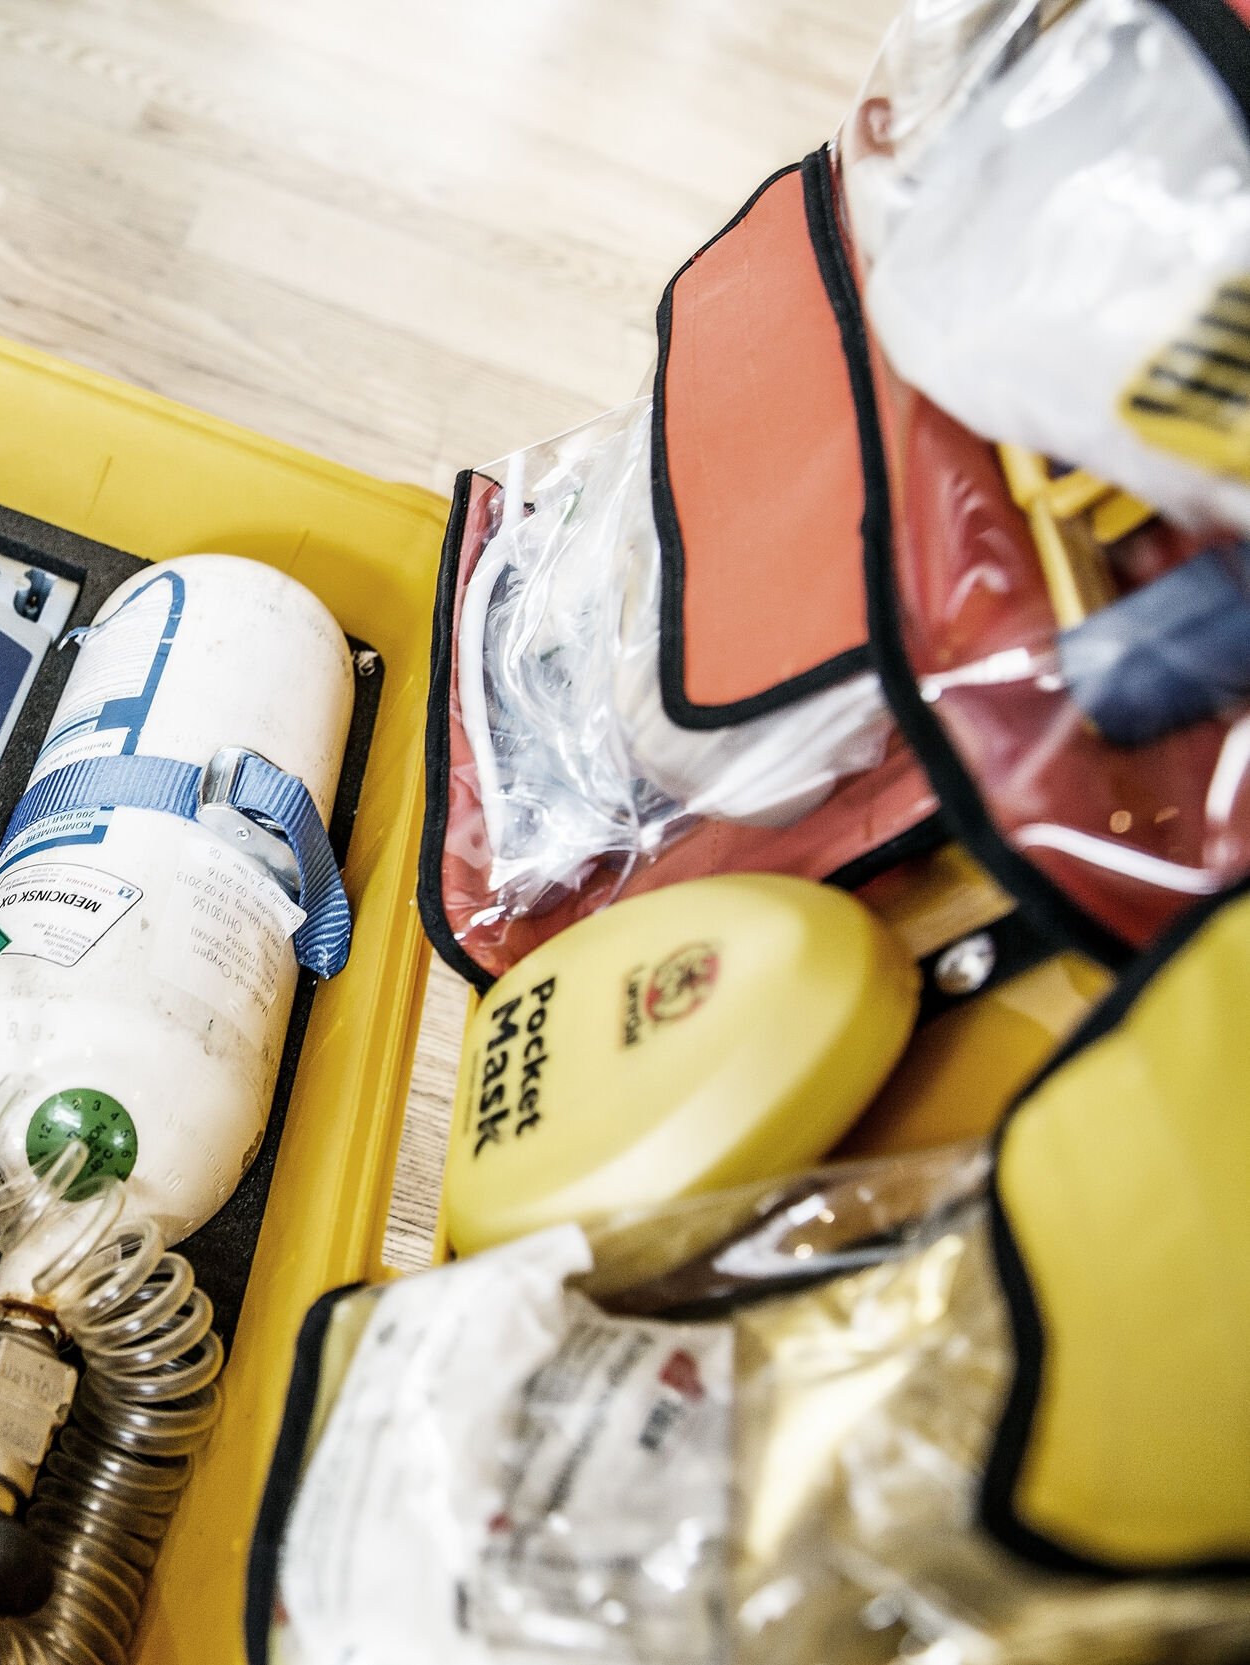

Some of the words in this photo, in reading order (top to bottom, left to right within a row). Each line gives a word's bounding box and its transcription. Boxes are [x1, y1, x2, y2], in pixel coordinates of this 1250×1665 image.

[52, 813, 74, 824] BAR
[75, 810, 95, 819] 200
[20, 821, 92, 847] KOMPRIMERET
[17, 890, 102, 913] MEDICINSK
[192, 945, 232, 978] Oxygen
[516, 977, 558, 1138] Pocket
[473, 996, 525, 1161] Mask
